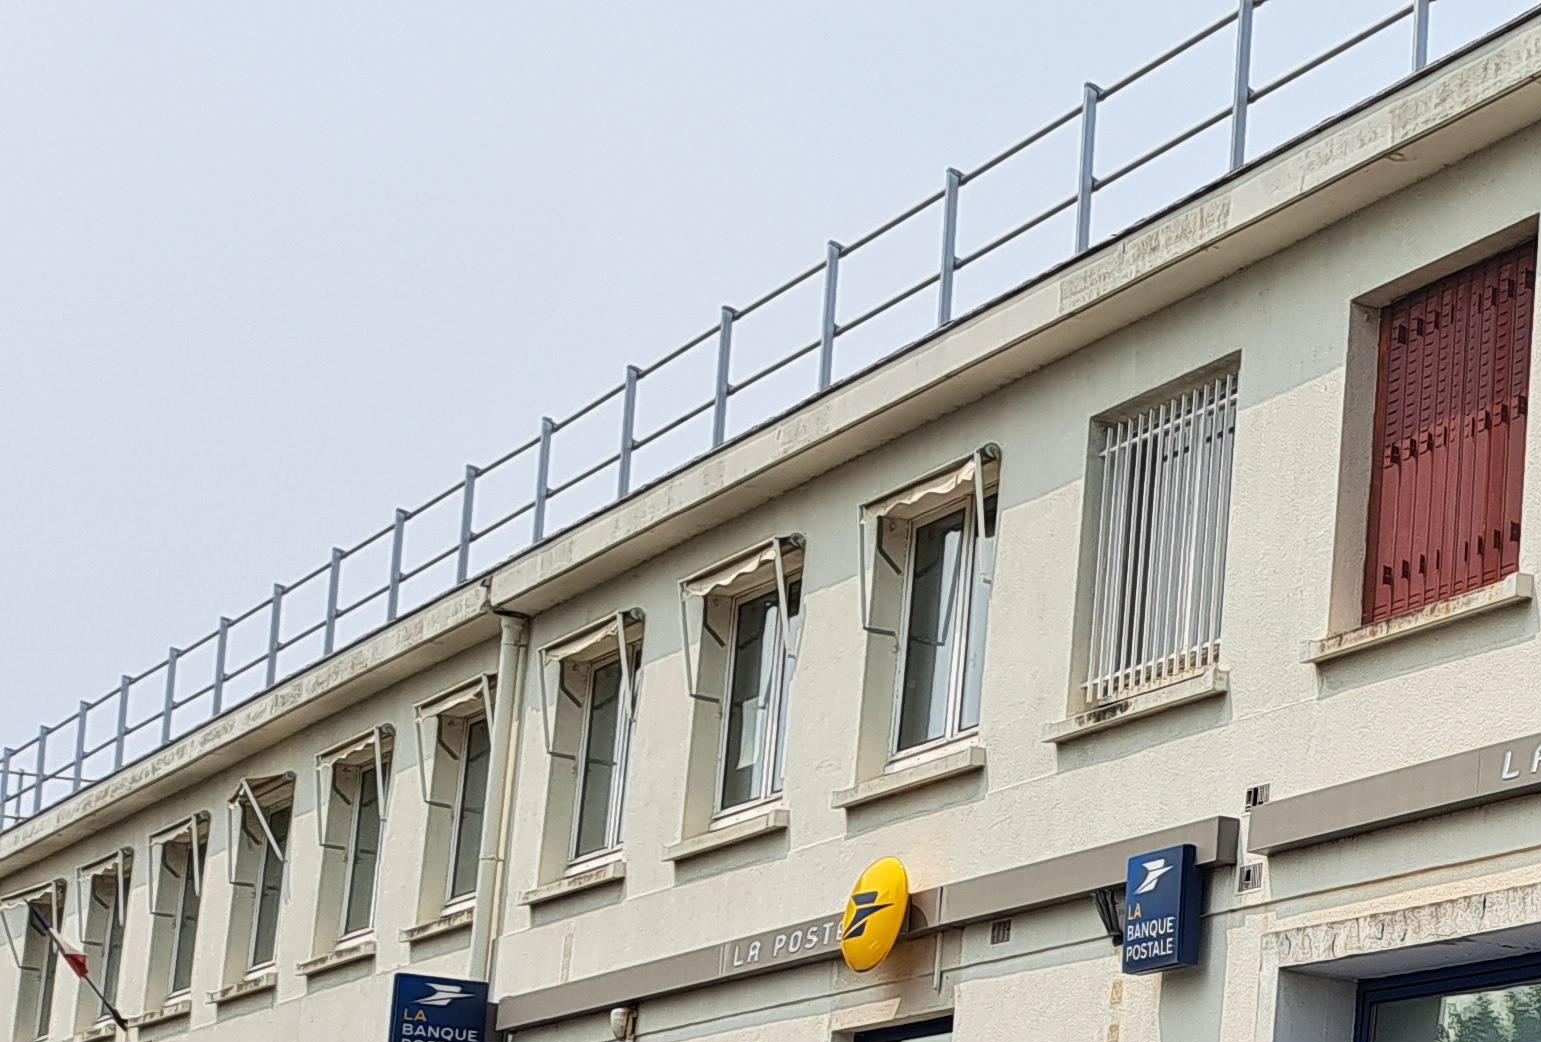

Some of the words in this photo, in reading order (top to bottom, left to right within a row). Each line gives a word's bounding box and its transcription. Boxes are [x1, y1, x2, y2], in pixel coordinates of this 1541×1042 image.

[1128, 903, 1142, 920] LA
[1127, 916, 1176, 941] BANQUE
[733, 941, 761, 967] LA
[1126, 938, 1173, 962] POSTALE
[403, 1008, 427, 1022] LA
[402, 1023, 479, 1042] BANQUE
